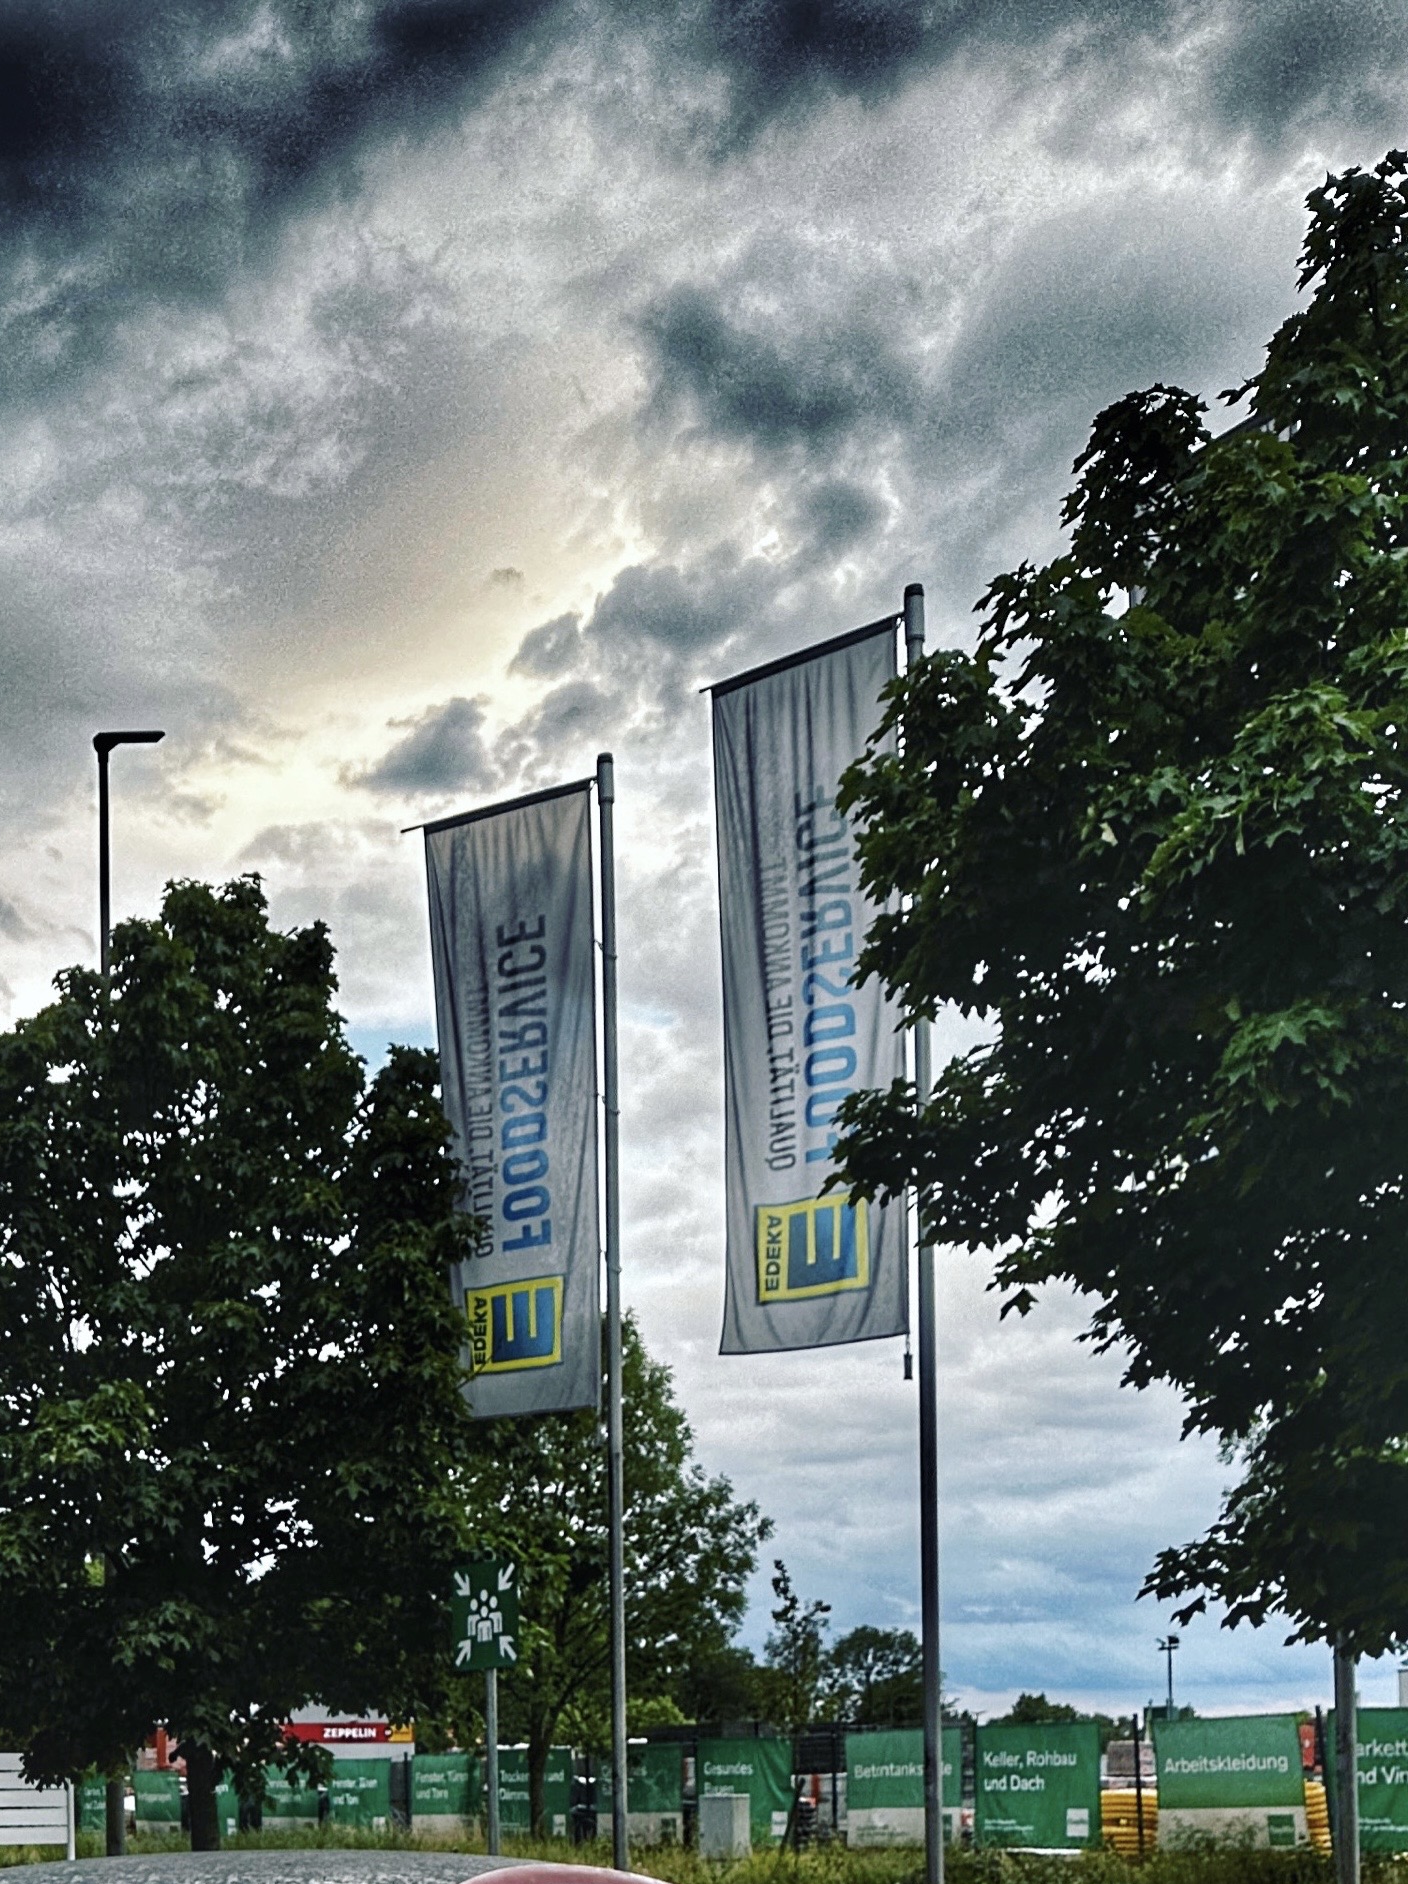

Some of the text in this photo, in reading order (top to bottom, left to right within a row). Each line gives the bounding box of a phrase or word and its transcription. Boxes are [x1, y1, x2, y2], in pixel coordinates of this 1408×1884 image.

[323, 1727, 377, 1739] ZEPPELIN
[1354, 1739, 1408, 1757] arkett
[983, 1750, 1078, 1769] Keller, Rohbau
[1164, 1753, 1289, 1773] Arbeitskleidung
[984, 1774, 1045, 1791] und Dach
[1355, 1766, 1377, 1785] nd
